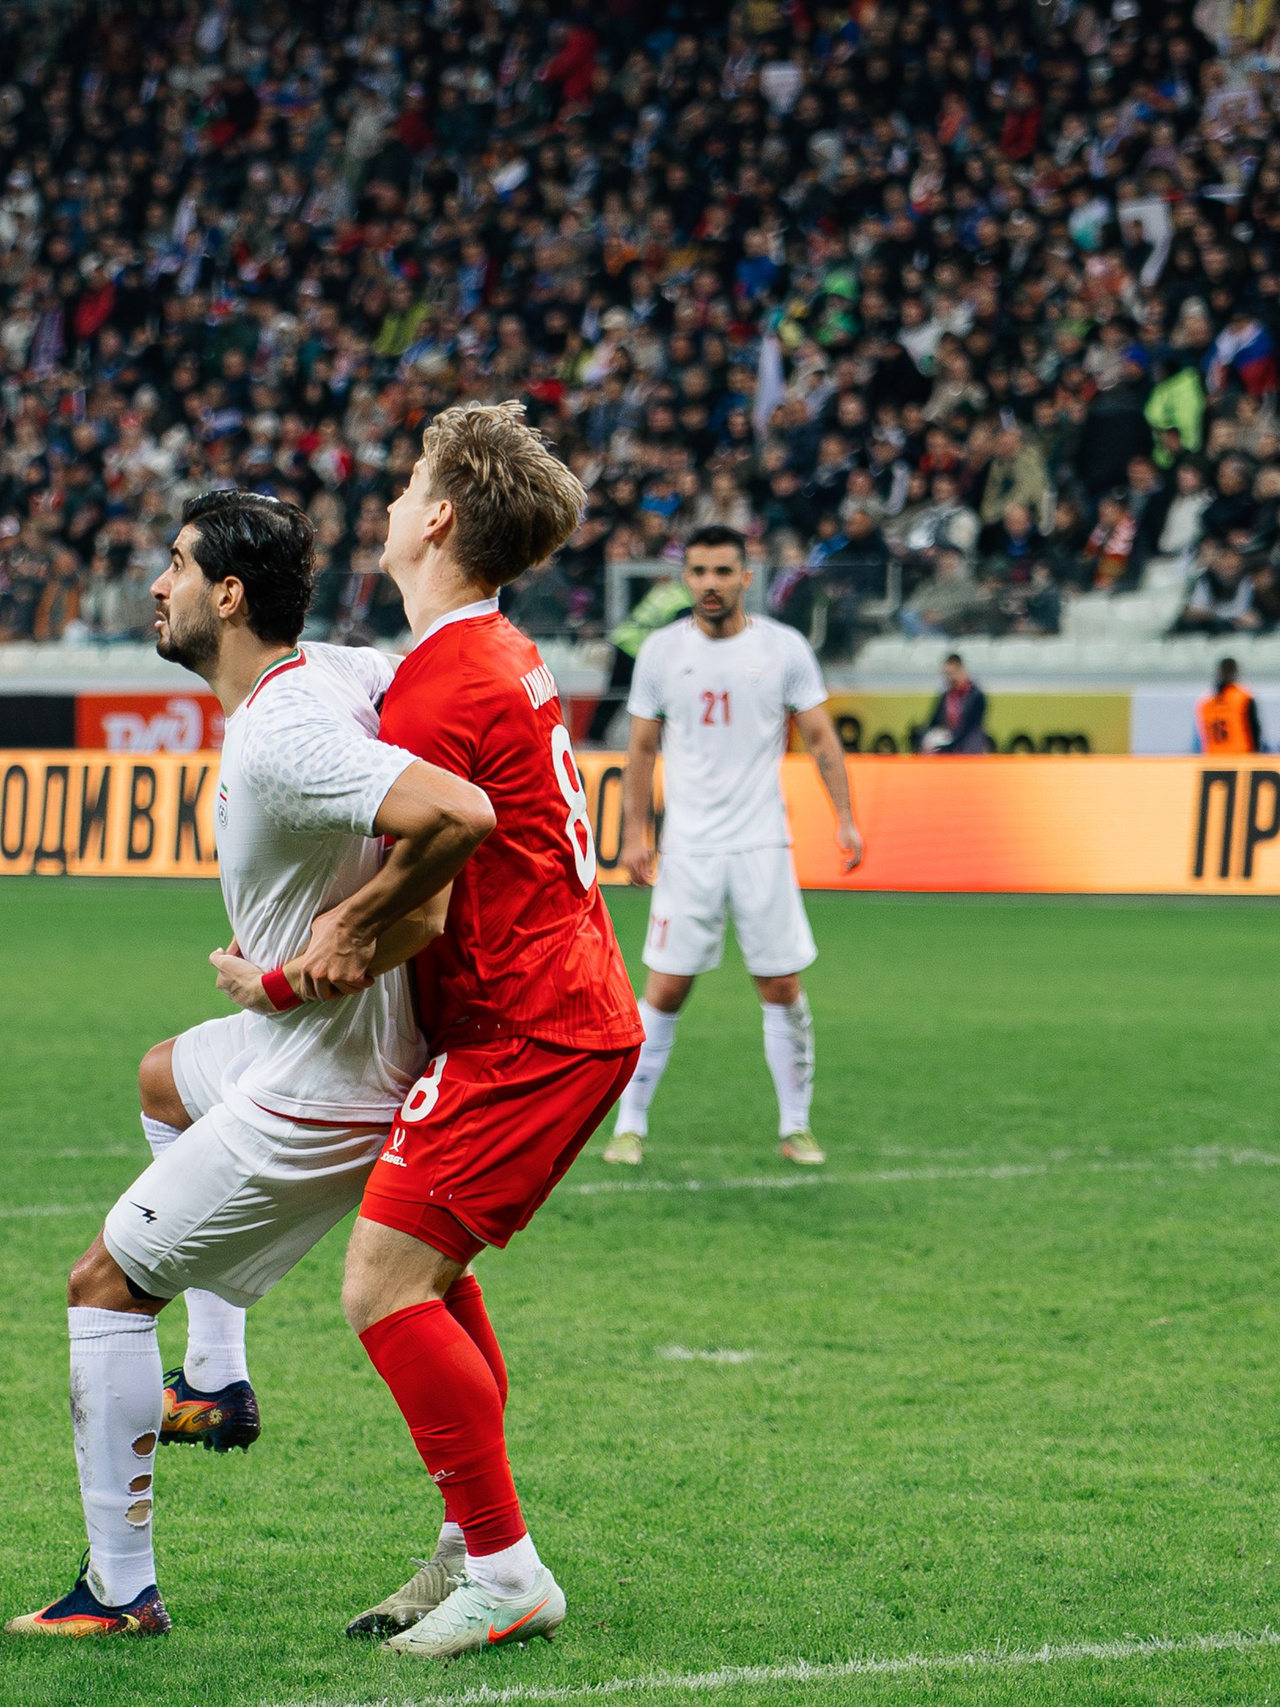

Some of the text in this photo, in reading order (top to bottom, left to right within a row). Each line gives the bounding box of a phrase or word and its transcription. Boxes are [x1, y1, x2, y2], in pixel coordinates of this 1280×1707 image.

[700, 690, 731, 726] 21
[551, 723, 597, 891] 8
[401, 1052, 448, 1122] 8
